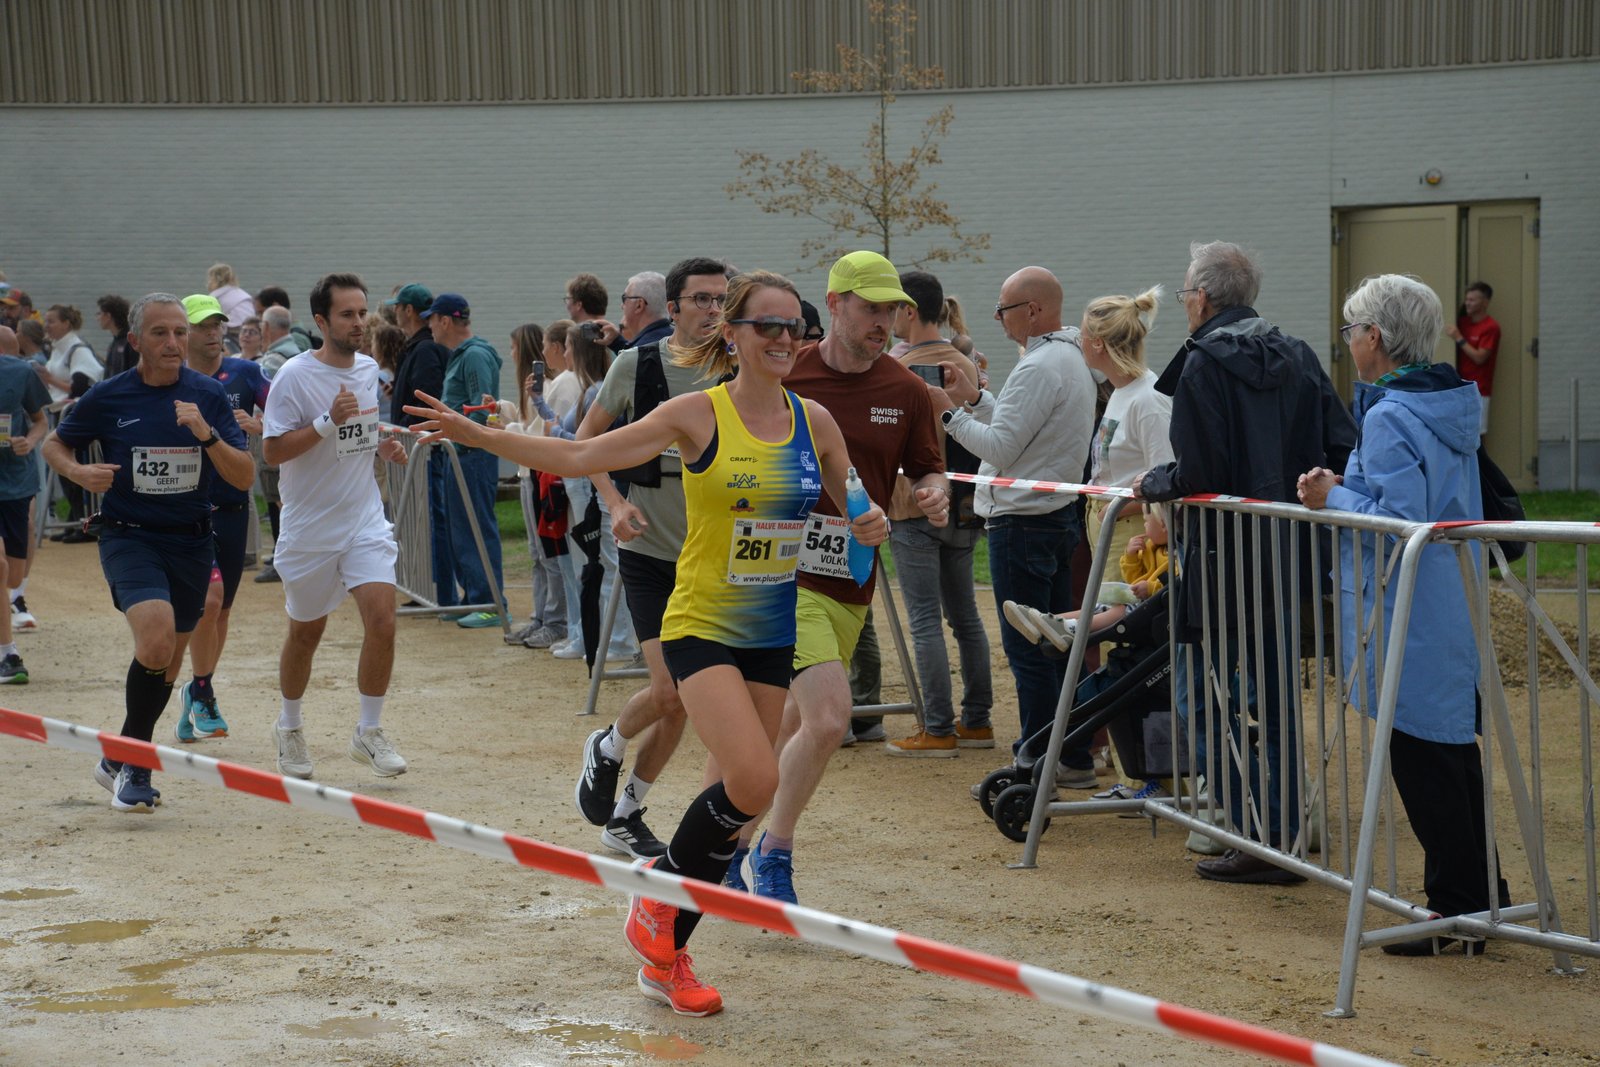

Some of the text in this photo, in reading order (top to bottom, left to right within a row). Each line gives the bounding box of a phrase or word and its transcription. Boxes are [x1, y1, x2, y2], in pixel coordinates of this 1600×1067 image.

[870, 414, 898, 425] alpine
[338, 423, 363, 441] 573
[356, 436, 370, 446] JARI
[137, 461, 169, 477] 432
[156, 477, 180, 486] GEERT
[146, 484, 194, 494] www.plusprint.b
[755, 521, 777, 530] HALVE
[825, 517, 847, 527] HALVE
[805, 531, 846, 555] 543
[735, 538, 772, 561] 261
